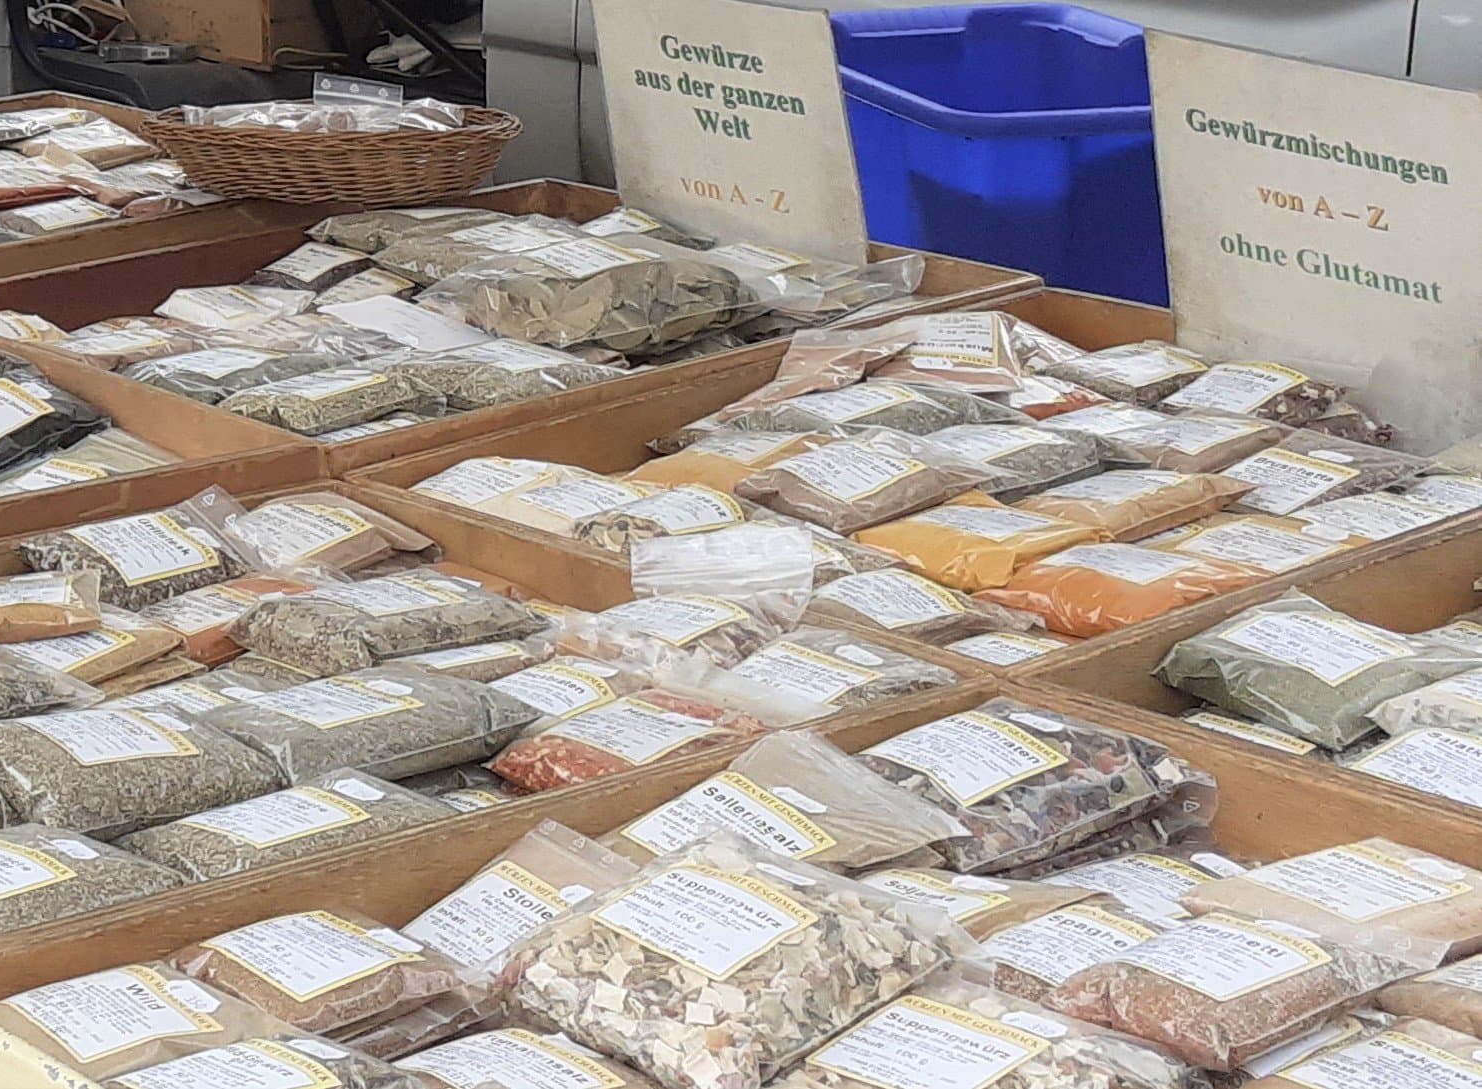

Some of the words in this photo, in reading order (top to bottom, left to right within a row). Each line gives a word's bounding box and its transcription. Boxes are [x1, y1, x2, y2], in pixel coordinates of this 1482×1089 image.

[659, 34, 764, 74] Gewürze
[634, 68, 671, 92] aus
[677, 72, 714, 100] der
[720, 83, 806, 115] ganzen
[693, 107, 752, 140] Welt
[1185, 108, 1448, 185] Gewürzmischungen
[680, 177, 720, 200] von
[730, 183, 748, 206] A
[770, 189, 790, 214] Z
[1257, 186, 1304, 212] von
[1313, 196, 1335, 219] A
[1366, 205, 1389, 231] Z
[1220, 233, 1287, 266] ohne
[1296, 248, 1443, 304] Glutamat
[944, 717, 1040, 764] Sauerbraten
[702, 785, 802, 853] Selleriesalz
[722, 773, 756, 796] WÜRZEN
[774, 802, 826, 844] GESCHMACK
[746, 879, 809, 920] GESCHMACK
[125, 983, 167, 1011] Wild
[971, 1018, 1039, 1050] GESCHMACK
